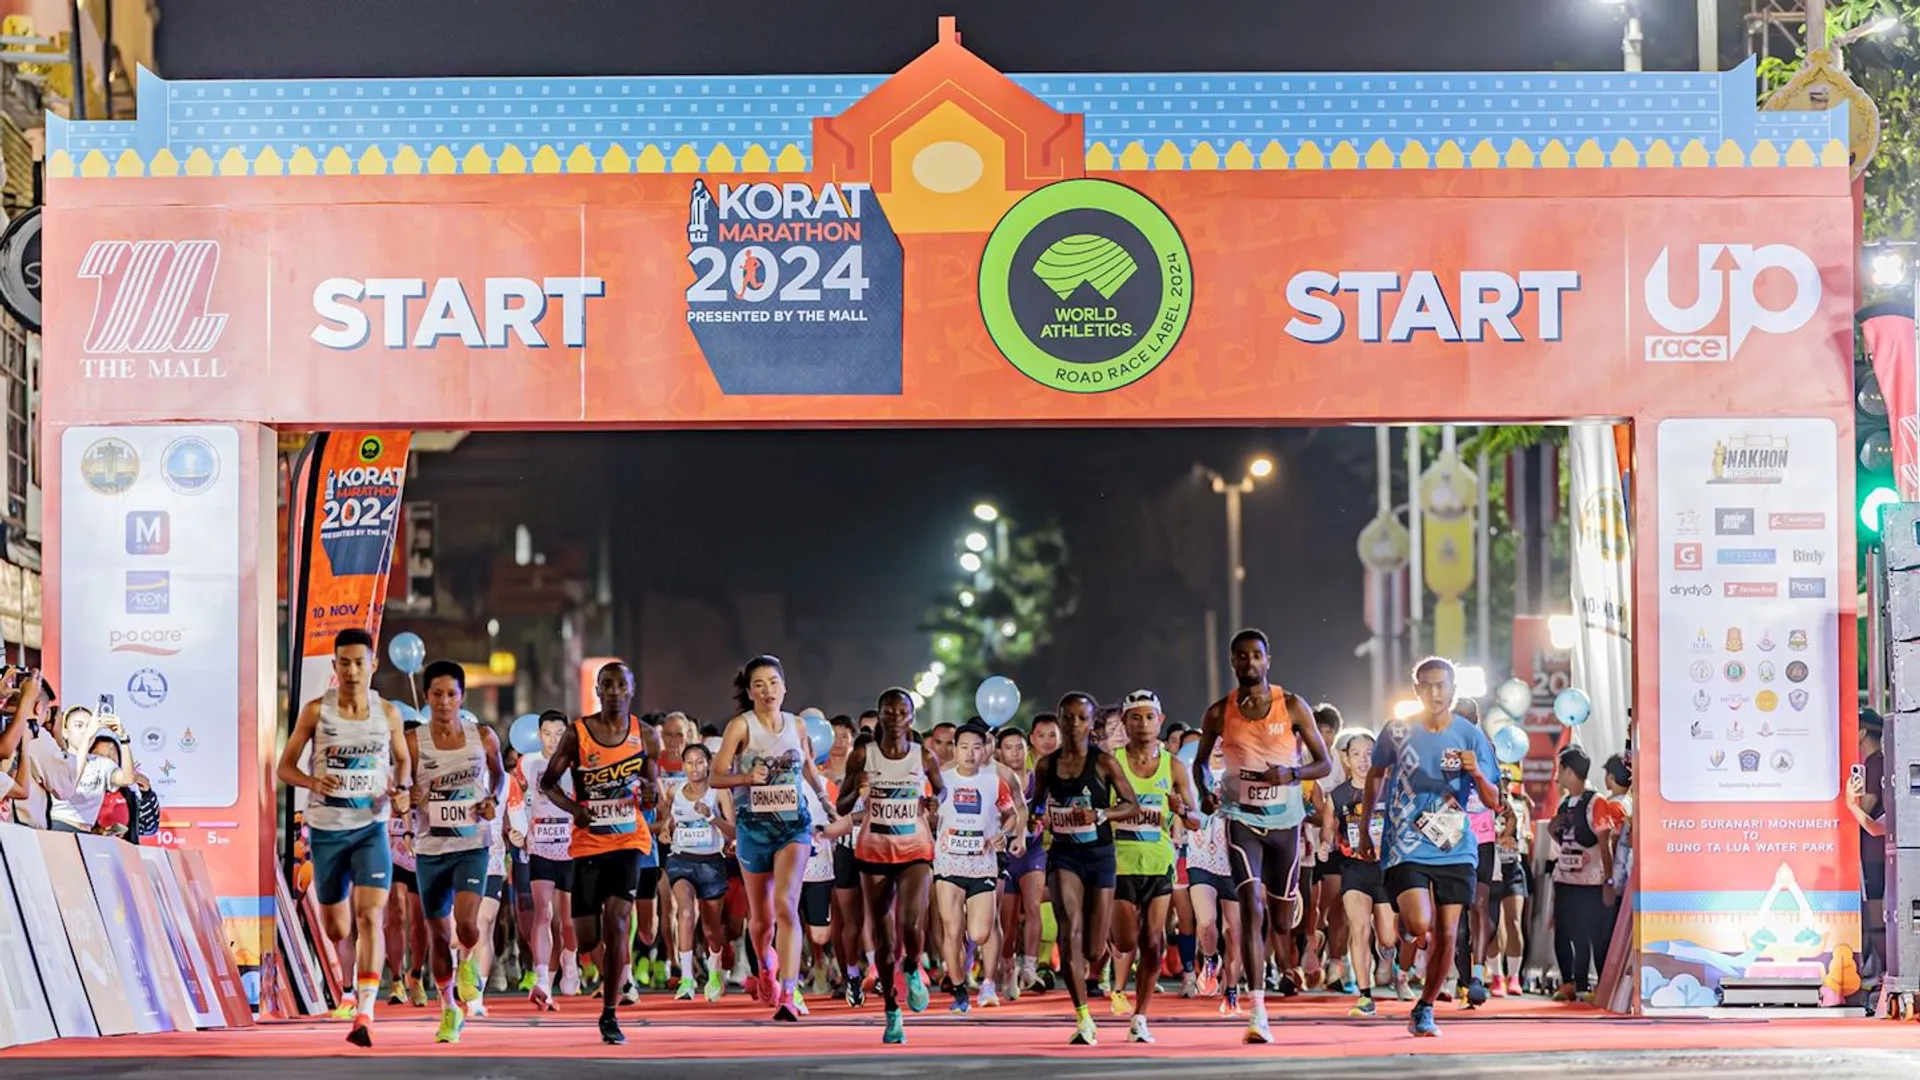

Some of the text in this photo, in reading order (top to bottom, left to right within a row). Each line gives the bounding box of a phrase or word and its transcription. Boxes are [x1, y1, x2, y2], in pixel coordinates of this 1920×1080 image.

[719, 182, 871, 219] KORAT
[719, 222, 861, 242] MARATHON
[686, 245, 870, 302] 2024
[310, 277, 605, 349] START
[1283, 270, 1580, 343] START
[687, 310, 868, 322] PRESENTED BY THE MALL
[1055, 308, 1118, 321] WORLD
[1056, 252, 1184, 383] ROAD RACE LABEL 2024
[1040, 323, 1132, 338] ATHLETICS
[1650, 339, 1722, 358] race
[80, 359, 227, 379] THE MALL
[1727, 449, 1788, 469] NAKHON
[337, 466, 404, 487] KORAT
[313, 606, 325, 618] 10
[330, 604, 360, 616] NOV
[141, 630, 182, 641] care
[1532, 671, 1569, 695] 20
[1440, 757, 1461, 768] 202
[1248, 786, 1278, 800] GEZU
[441, 806, 466, 821] DON
[872, 803, 917, 819] SYOKAU
[1661, 818, 1840, 829] THAO SURANARI MONUMENT
[157, 831, 186, 844] 10 km
[207, 831, 230, 844] 5 km
[537, 827, 566, 836] PACER
[1742, 831, 1758, 840] TO
[951, 838, 980, 848] PACER
[1666, 843, 1834, 853] BUNG TA LUA WATER PARK
